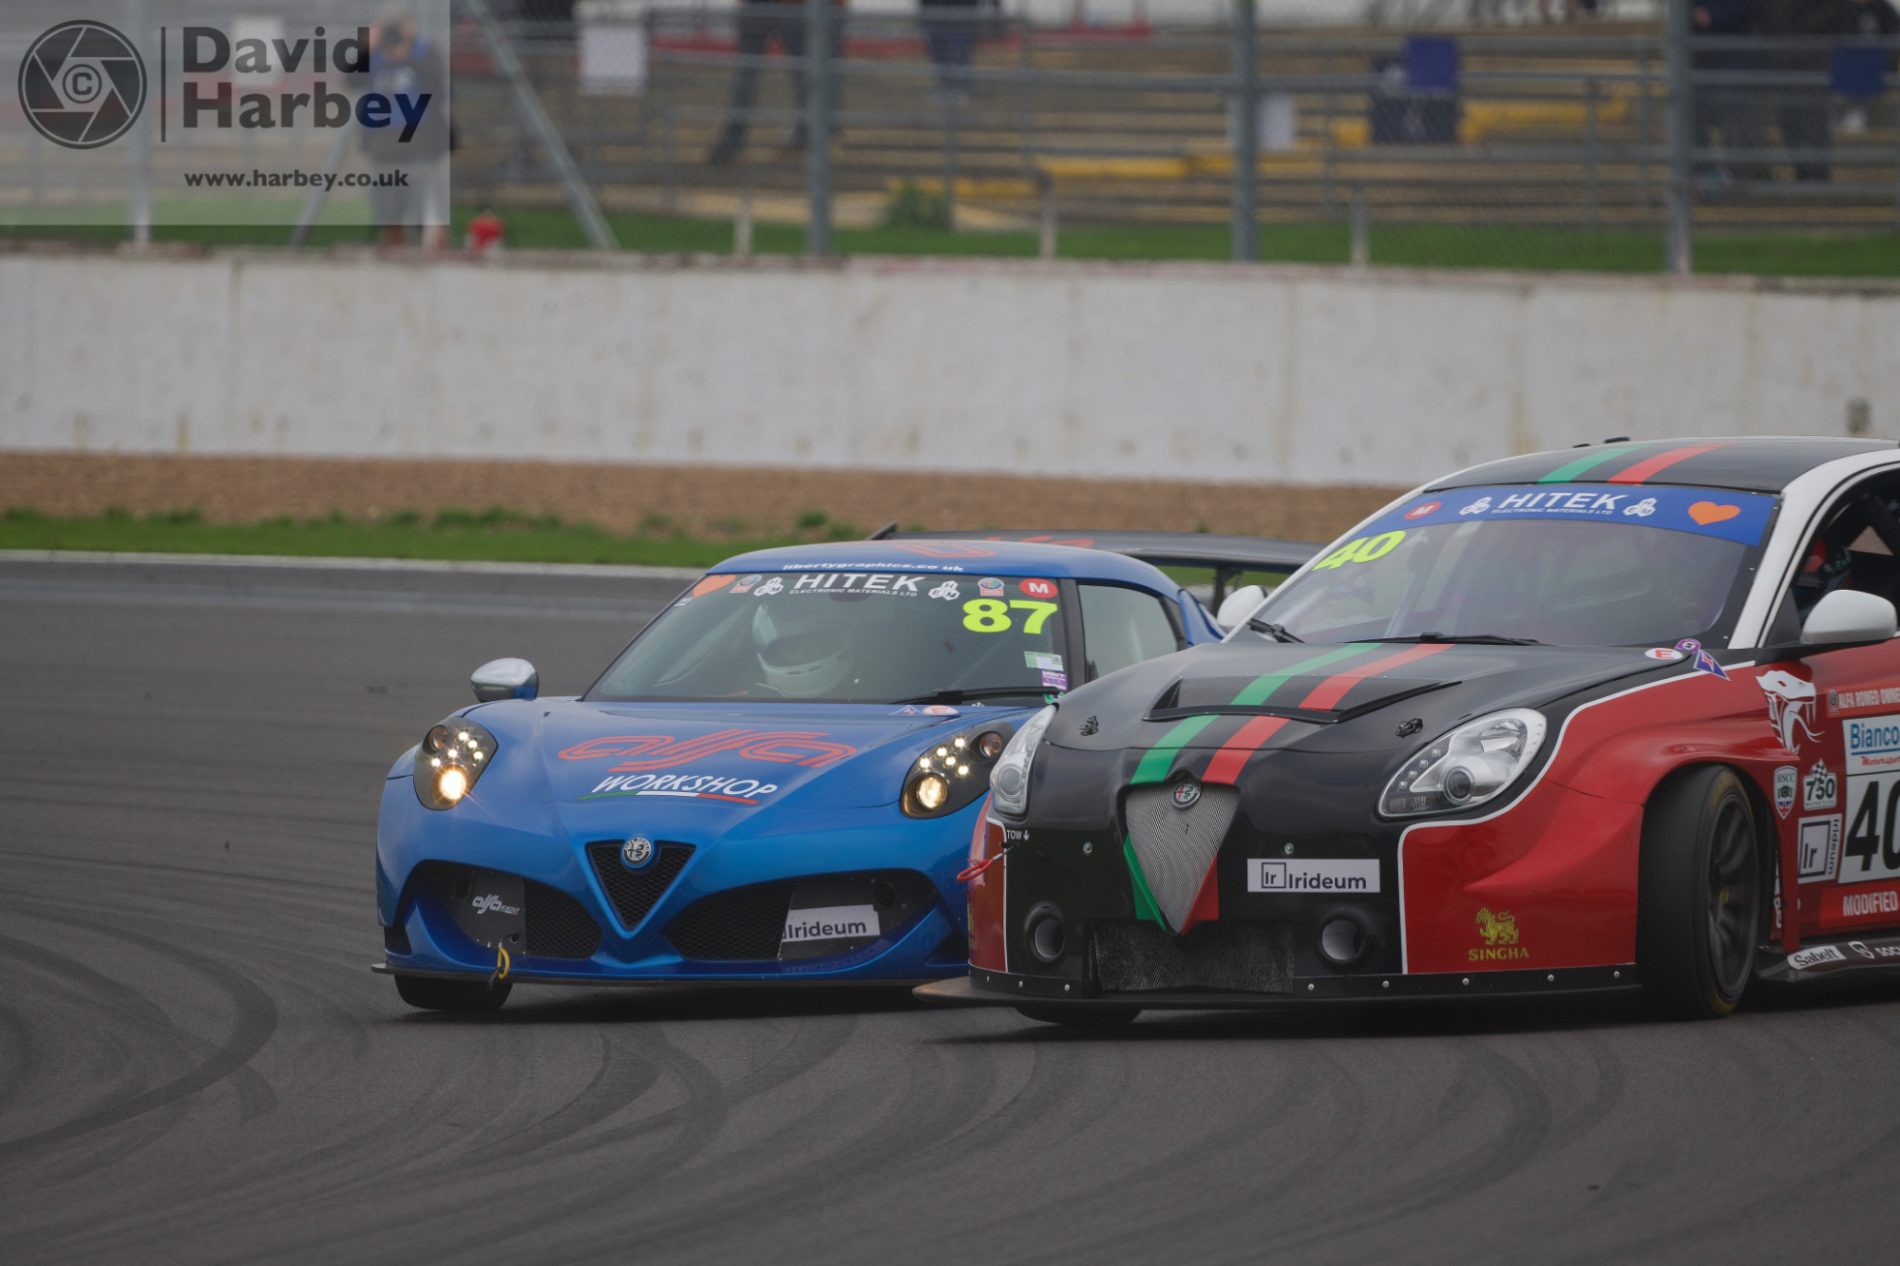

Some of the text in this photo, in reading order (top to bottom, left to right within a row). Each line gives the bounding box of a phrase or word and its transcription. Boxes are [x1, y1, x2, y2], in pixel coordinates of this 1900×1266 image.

[1498, 492, 1629, 510] HITEK
[1312, 530, 1407, 571] 40
[793, 574, 926, 592] HITEK
[1028, 582, 1049, 594] M
[846, 588, 899, 597] MATERIALS
[962, 598, 1058, 634] 87
[1851, 722, 1900, 749] Bianco
[592, 774, 778, 798] WORKSHOP
[1806, 778, 1835, 801] 750
[1007, 829, 1022, 840] TOW
[1288, 873, 1367, 890] Irideum
[1842, 890, 1899, 917] MODIFIED
[788, 921, 867, 939] Irideum
[1468, 947, 1530, 961] SINGHA
[1794, 948, 1839, 967] Sabelt
